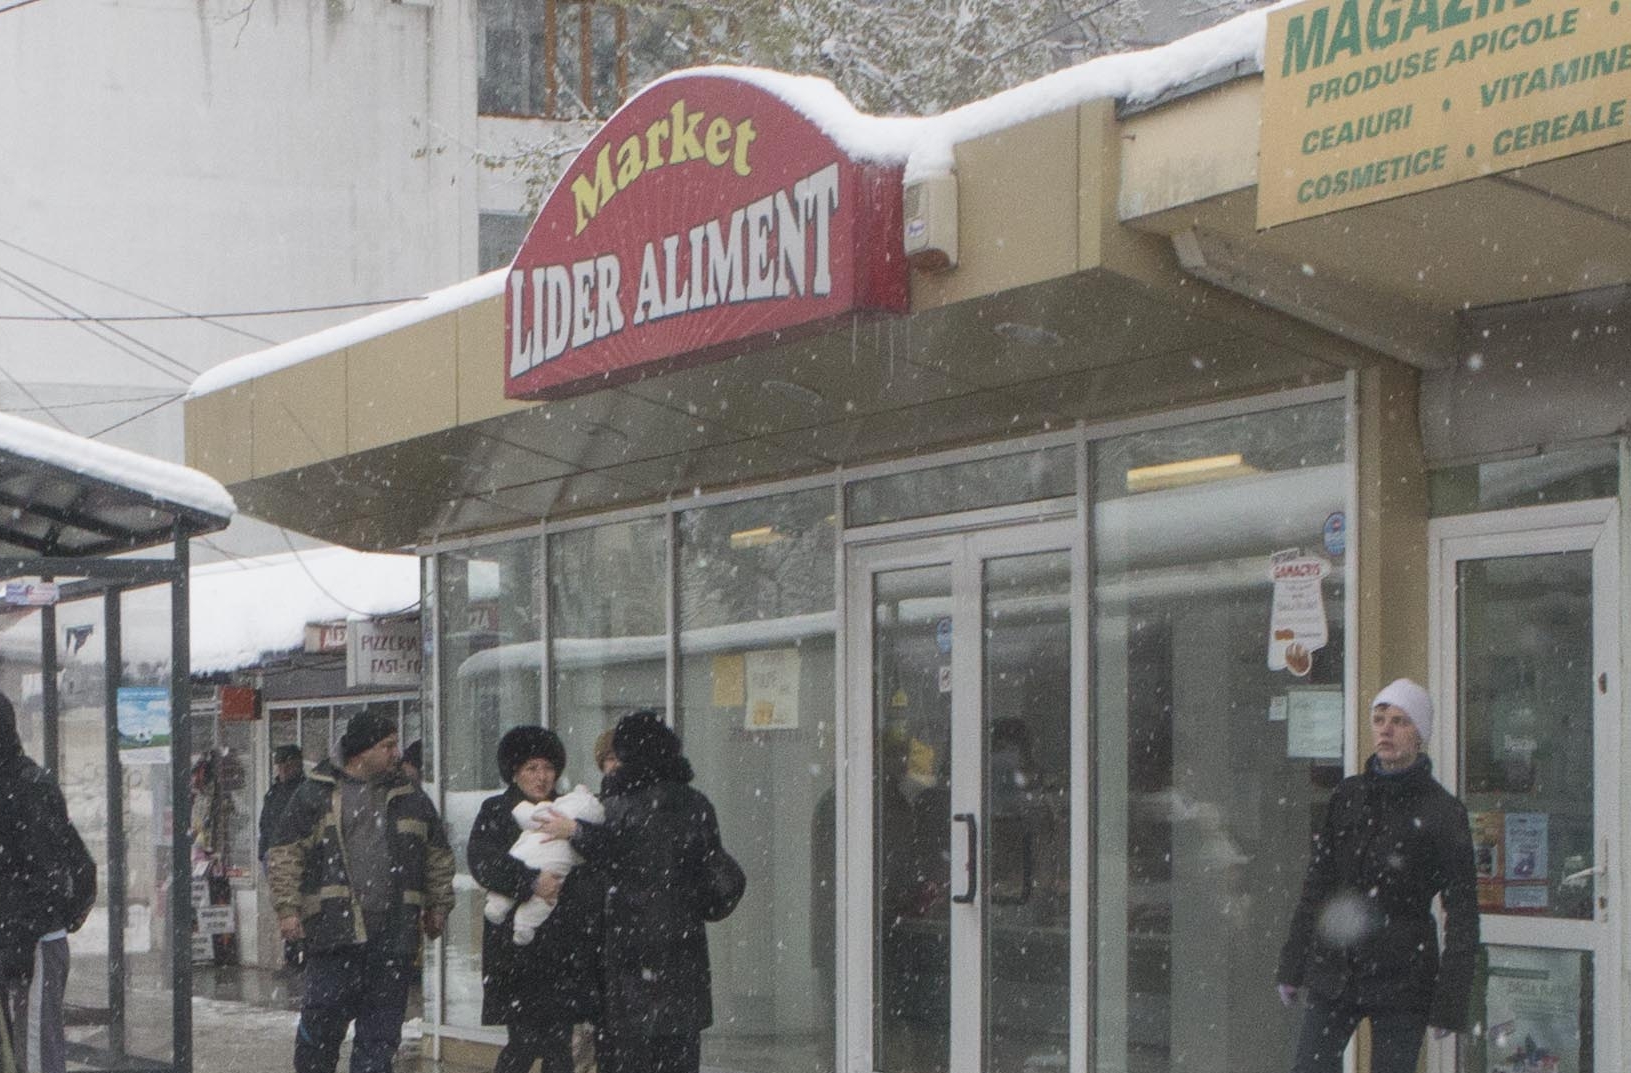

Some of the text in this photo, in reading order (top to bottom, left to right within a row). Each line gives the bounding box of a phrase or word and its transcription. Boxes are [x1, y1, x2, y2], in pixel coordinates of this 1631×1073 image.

[1281, 0, 1532, 78] MAGA
[1306, 8, 1580, 108] PRODUSE APICOLE
[1297, 100, 1627, 204] COSMETICE CEREALE
[1301, 44, 1631, 155] CEAIURI VITAMINE
[570, 100, 757, 237] Market
[509, 162, 839, 379] LIDER ALIMENT
